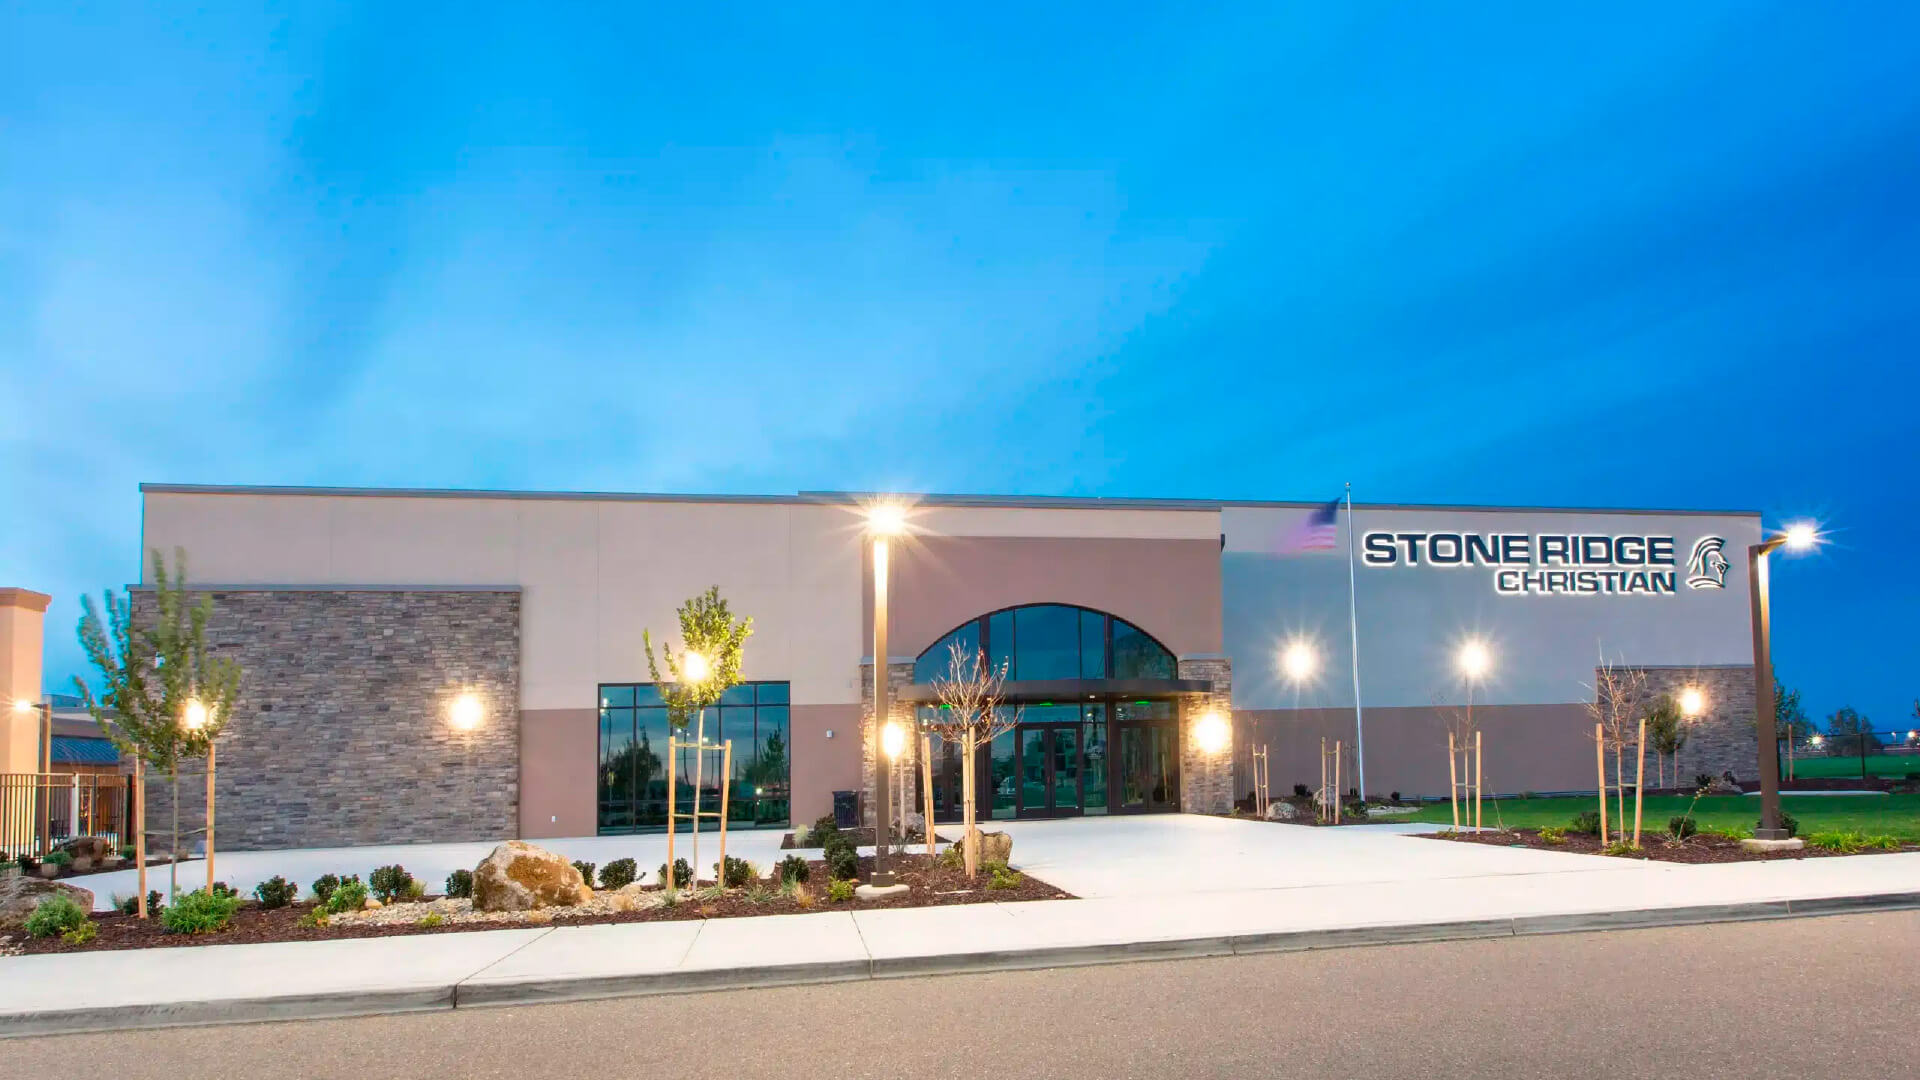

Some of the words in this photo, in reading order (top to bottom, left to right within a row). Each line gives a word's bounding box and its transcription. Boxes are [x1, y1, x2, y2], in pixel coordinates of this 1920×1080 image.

[1364, 532, 1530, 565] STONE
[1538, 535, 1675, 566] RIDGE
[1498, 570, 1675, 593] CHRISTIAN
